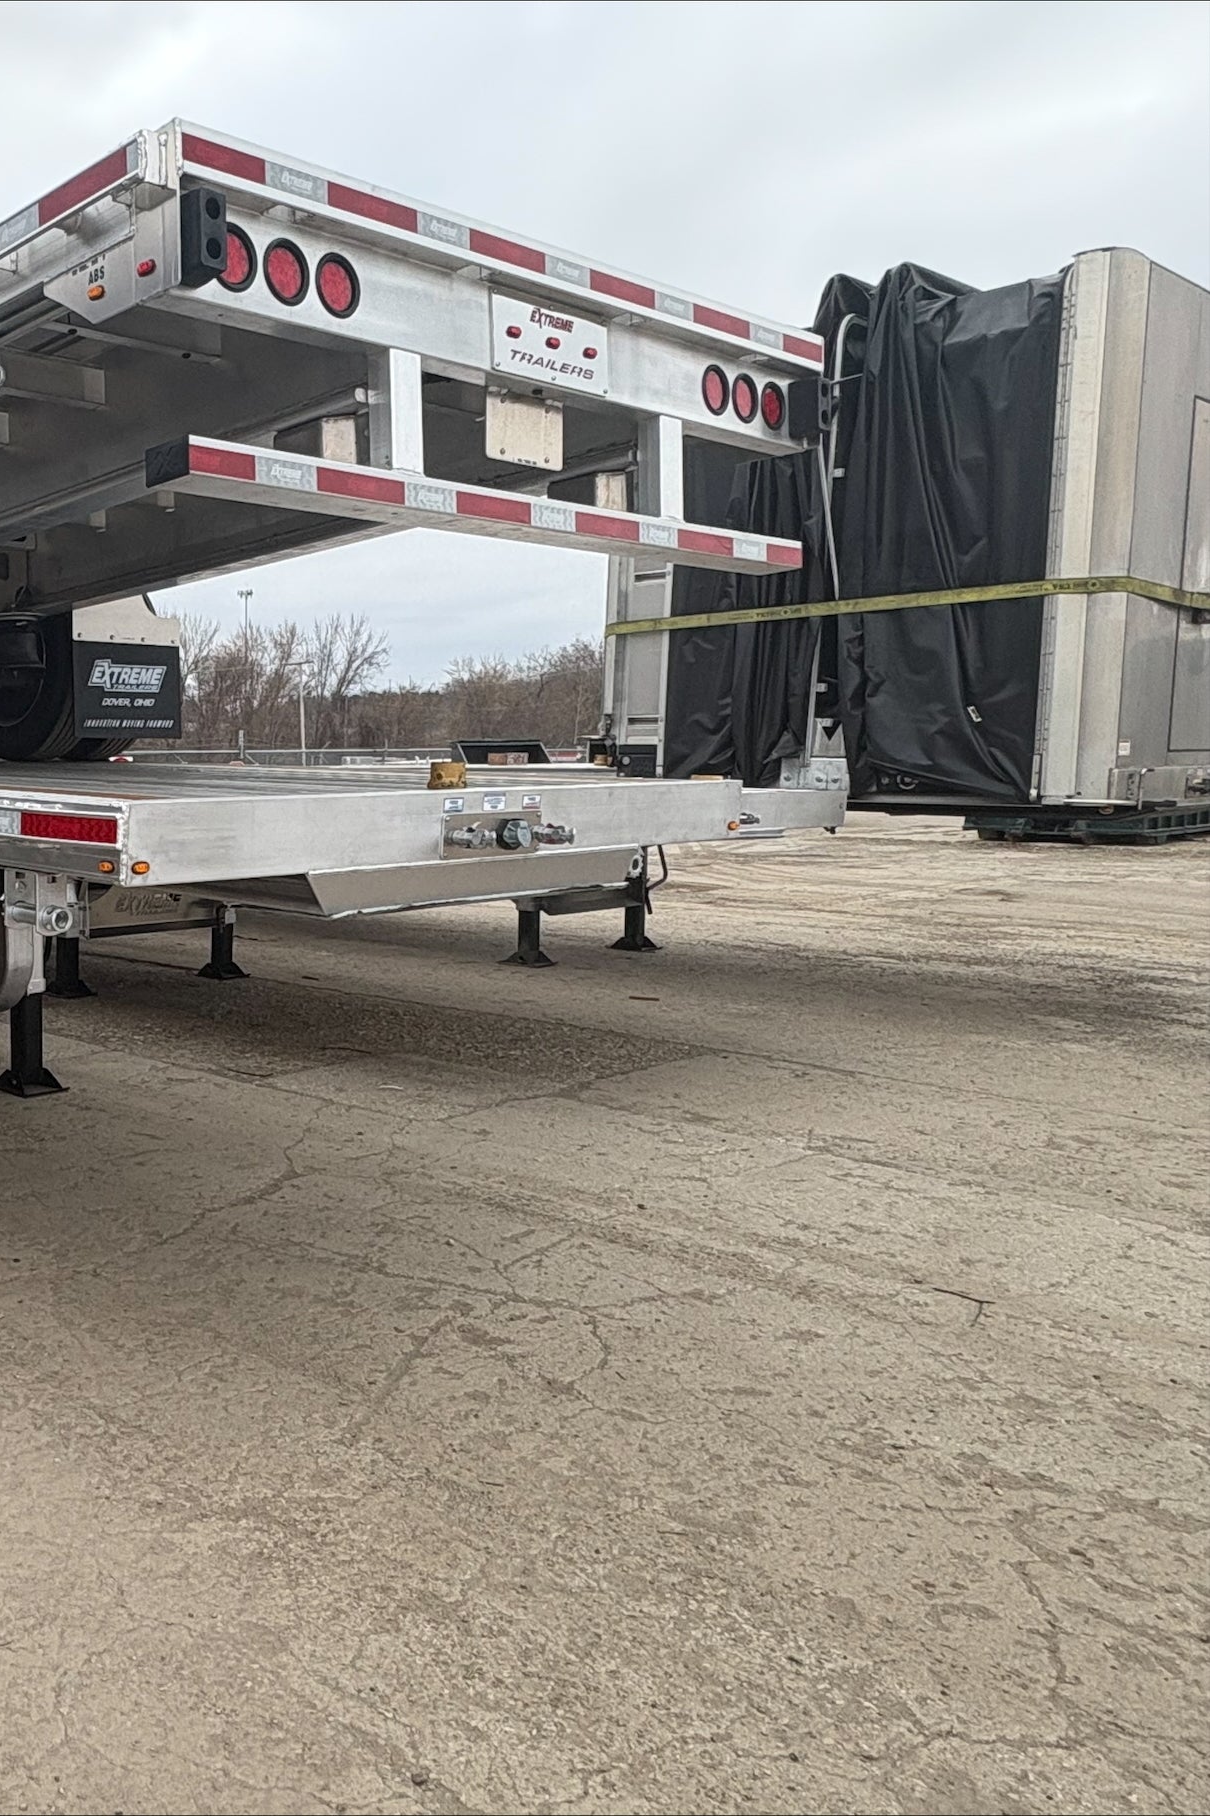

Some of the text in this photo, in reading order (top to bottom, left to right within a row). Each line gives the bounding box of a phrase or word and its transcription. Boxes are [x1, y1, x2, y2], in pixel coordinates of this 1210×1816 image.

[88, 265, 105, 286] ABS
[530, 307, 574, 334] EXTREME
[510, 349, 594, 380] TRAILERS
[92, 662, 164, 689] EXTREME
[133, 698, 156, 707] OHIO
